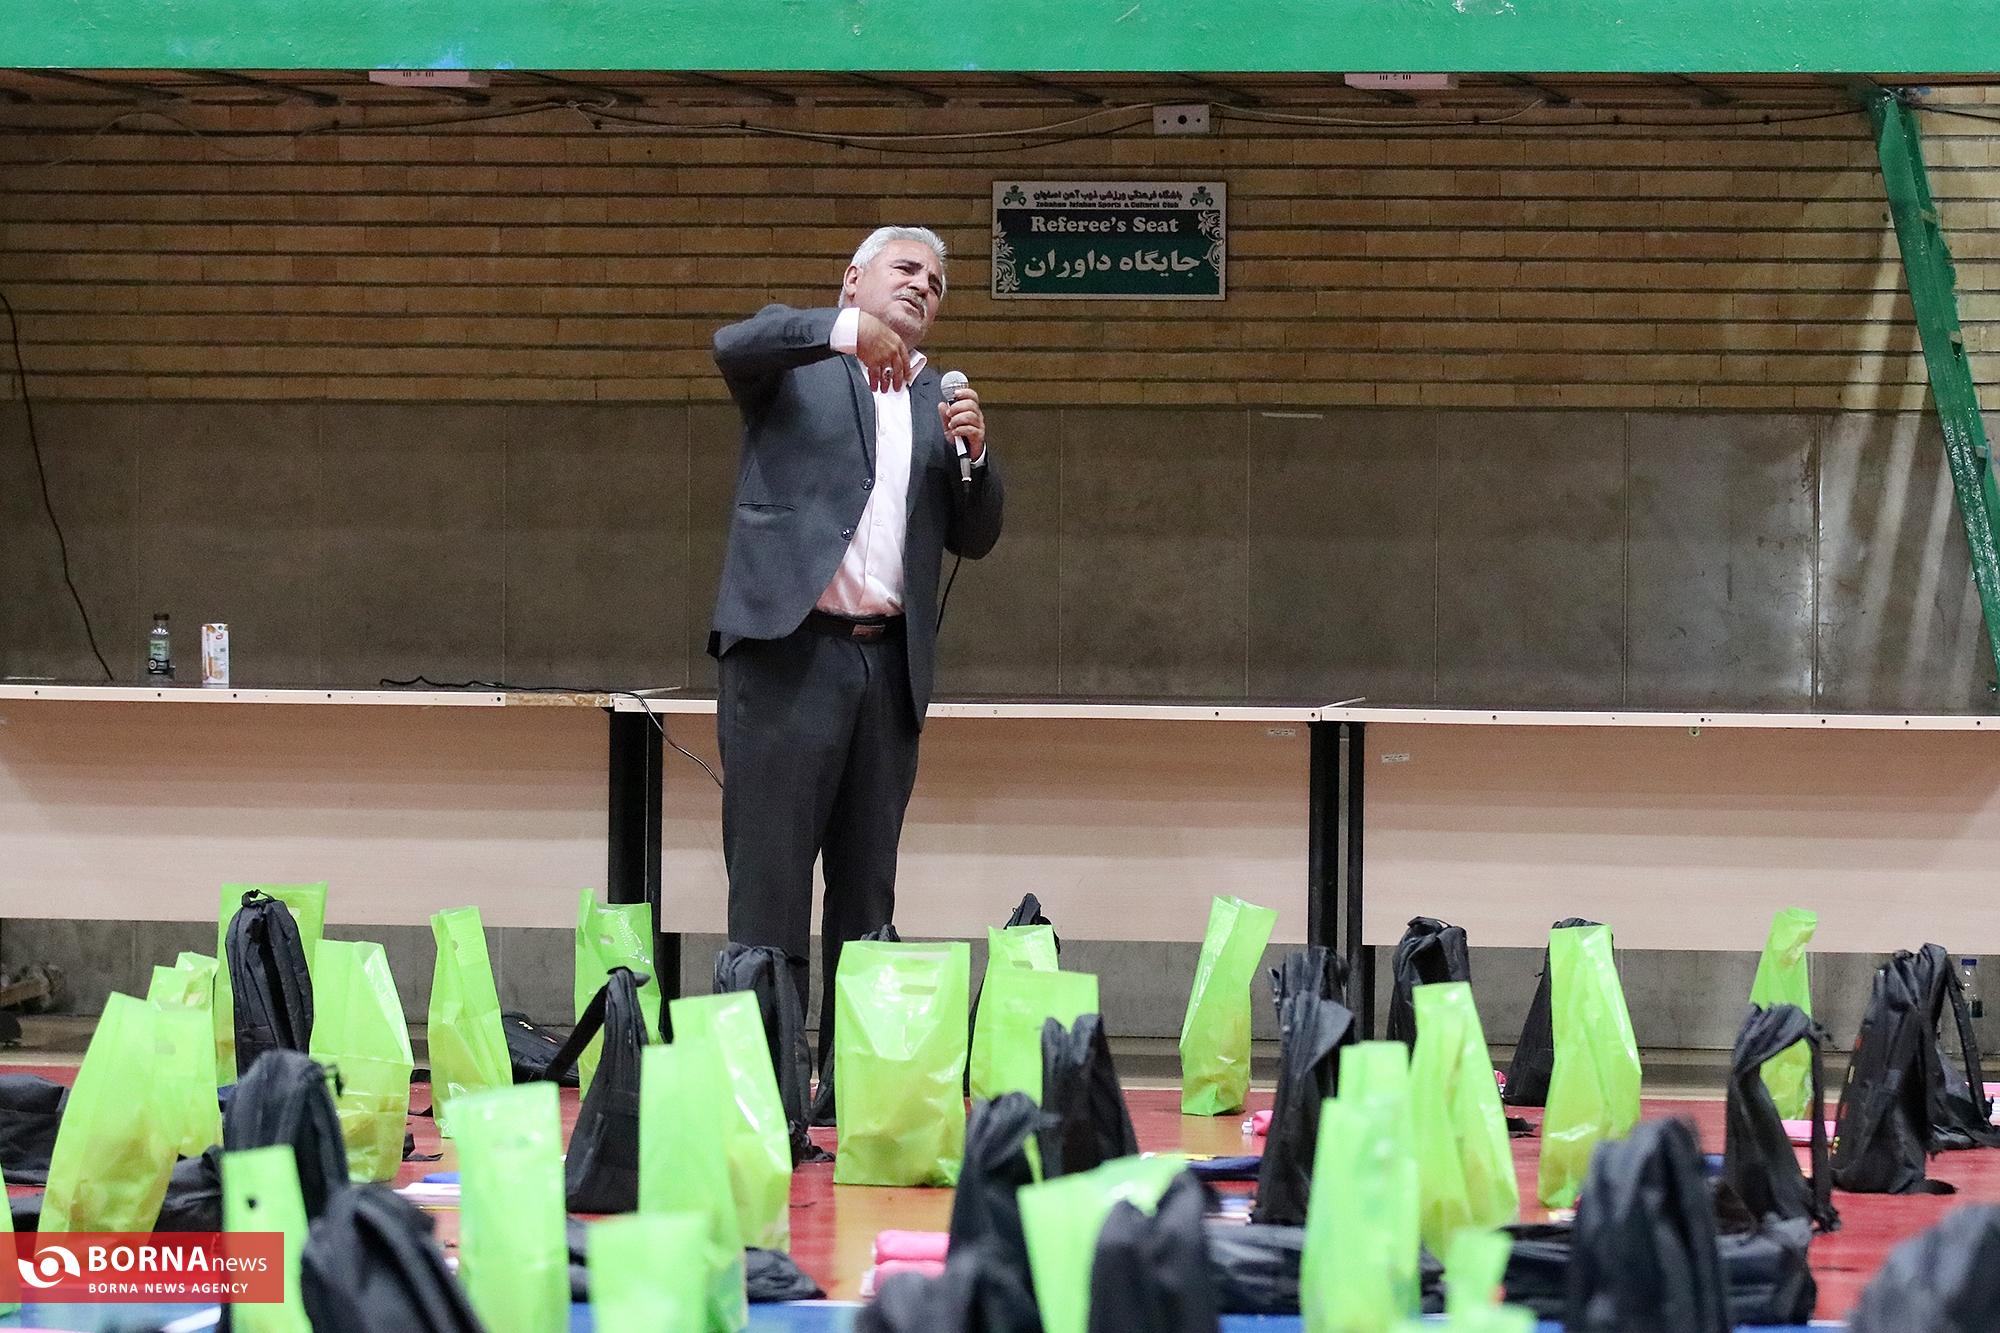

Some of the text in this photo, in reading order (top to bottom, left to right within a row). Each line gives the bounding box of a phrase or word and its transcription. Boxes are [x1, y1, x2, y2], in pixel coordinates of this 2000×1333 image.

[1030, 216, 1179, 233] Referee's Seat
[1024, 249, 1201, 278] جایگاه داوران
